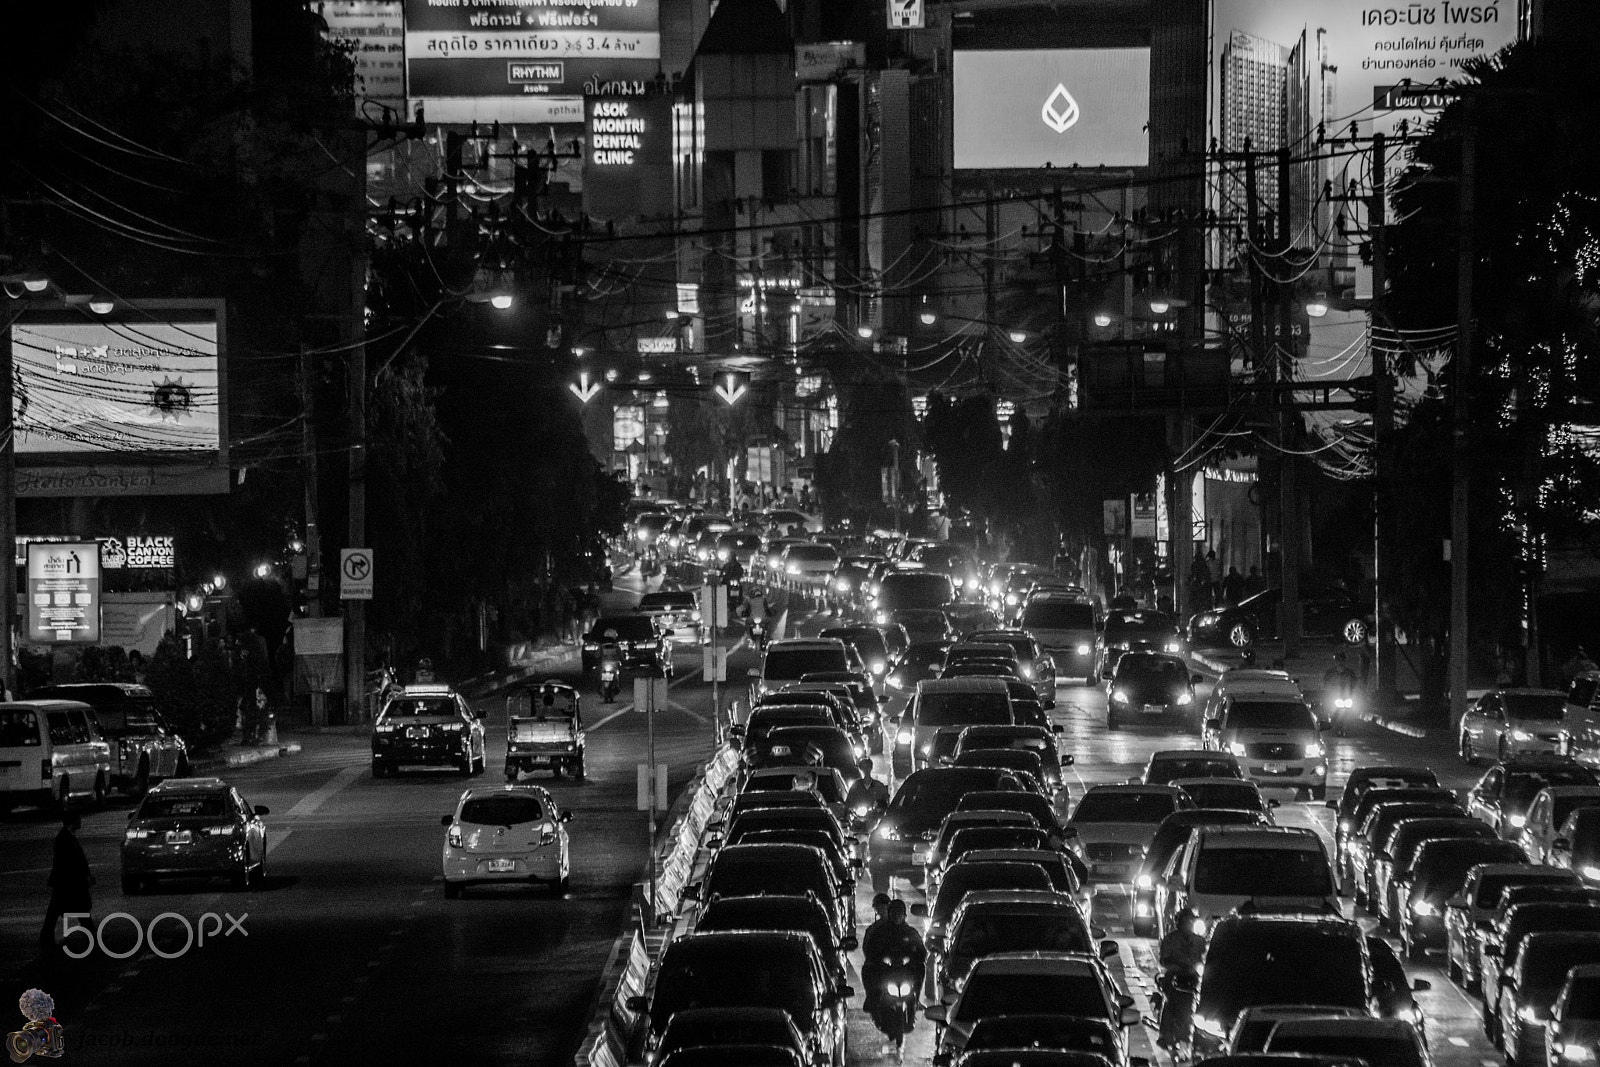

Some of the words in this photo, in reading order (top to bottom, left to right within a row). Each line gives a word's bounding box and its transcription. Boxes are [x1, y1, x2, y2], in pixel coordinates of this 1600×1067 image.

[1362, 4, 1436, 26] เดอะนิช
[1442, 1, 1499, 25] ไพรด์
[427, 35, 479, 56] สตูดิโอ
[484, 35, 559, 51] ราคาเดียว
[586, 37, 610, 51] 3.4
[1374, 36, 1436, 52] คอนโดใหม่
[1439, 33, 1484, 53] คุ้มที่สุด
[1362, 56, 1436, 70] ย่านทองหล่อ
[512, 65, 560, 79] RHYTHM
[523, 84, 549, 93] Asoke
[593, 102, 629, 117] ASOK
[592, 119, 646, 133] MONTRI
[593, 135, 642, 149] DENTAL
[593, 150, 635, 165] CLINIC
[15, 472, 74, 494] Hello
[127, 536, 174, 547] BLACK
[127, 547, 174, 556] CANYON
[127, 556, 174, 564] COFFEE
